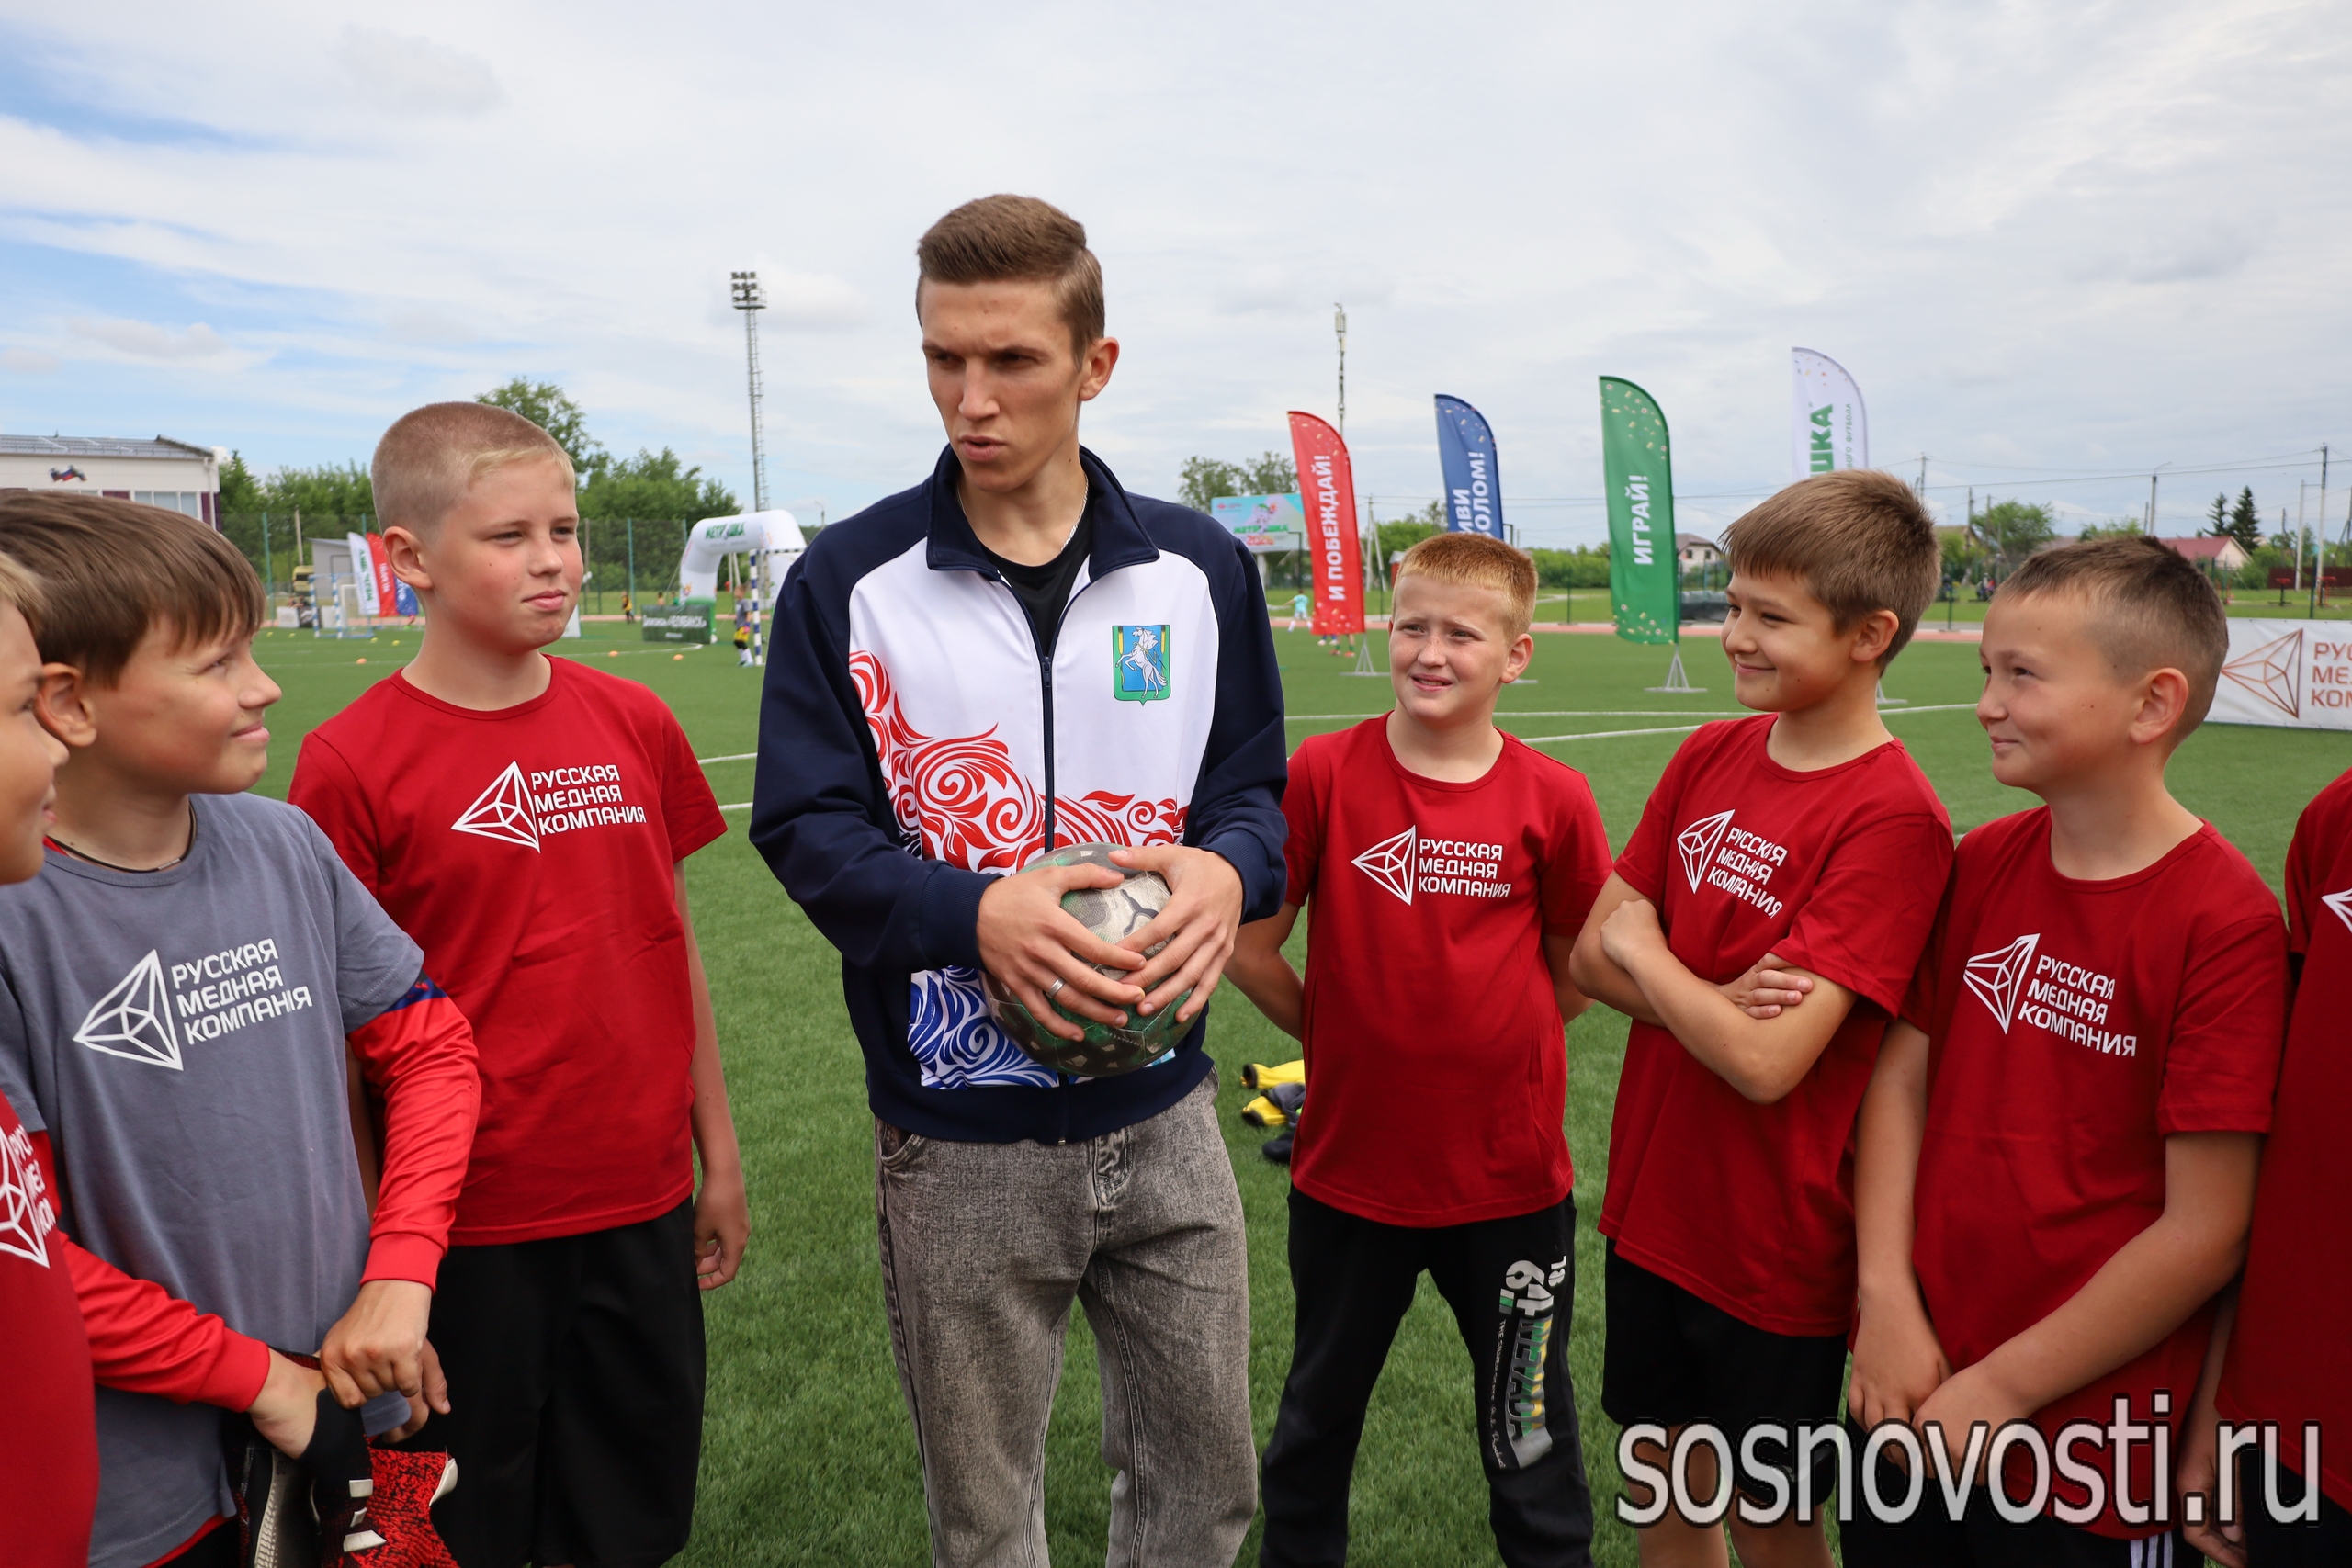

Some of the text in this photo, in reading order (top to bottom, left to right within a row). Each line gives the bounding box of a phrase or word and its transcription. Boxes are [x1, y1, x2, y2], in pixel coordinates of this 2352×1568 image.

[1809, 404, 1834, 477] ШКА
[1453, 488, 1475, 535] ИВИ
[1467, 452, 1492, 535] ОЛОМ!
[1311, 455, 1345, 601] И ПОБЕЖДАЙ!
[1624, 475, 1653, 565] ИГРАЙ!
[2312, 665, 2352, 685] МЕ
[530, 764, 621, 791] РУССКАЯ
[533, 784, 624, 814] МЕДНАЯ
[537, 806, 647, 836] КОМПАНИЯ
[1419, 838, 1503, 862] РУССКАЯ
[1419, 857, 1498, 880] МЕДНАЯ
[1715, 846, 1773, 886] МЕДНАЯ
[1418, 876, 1512, 897] КОМПАНИЯ
[171, 938, 279, 989] РУССКАЯ
[2035, 954, 2116, 1000] РУССКАЯ
[176, 964, 285, 1018] МЕДНАЯ
[2026, 978, 2109, 1025] МЕДНАЯ
[2018, 1000, 2137, 1057] КОМПАНИЯ
[1505, 1259, 1555, 1317] 64
[1497, 1318, 1507, 1340] THE
